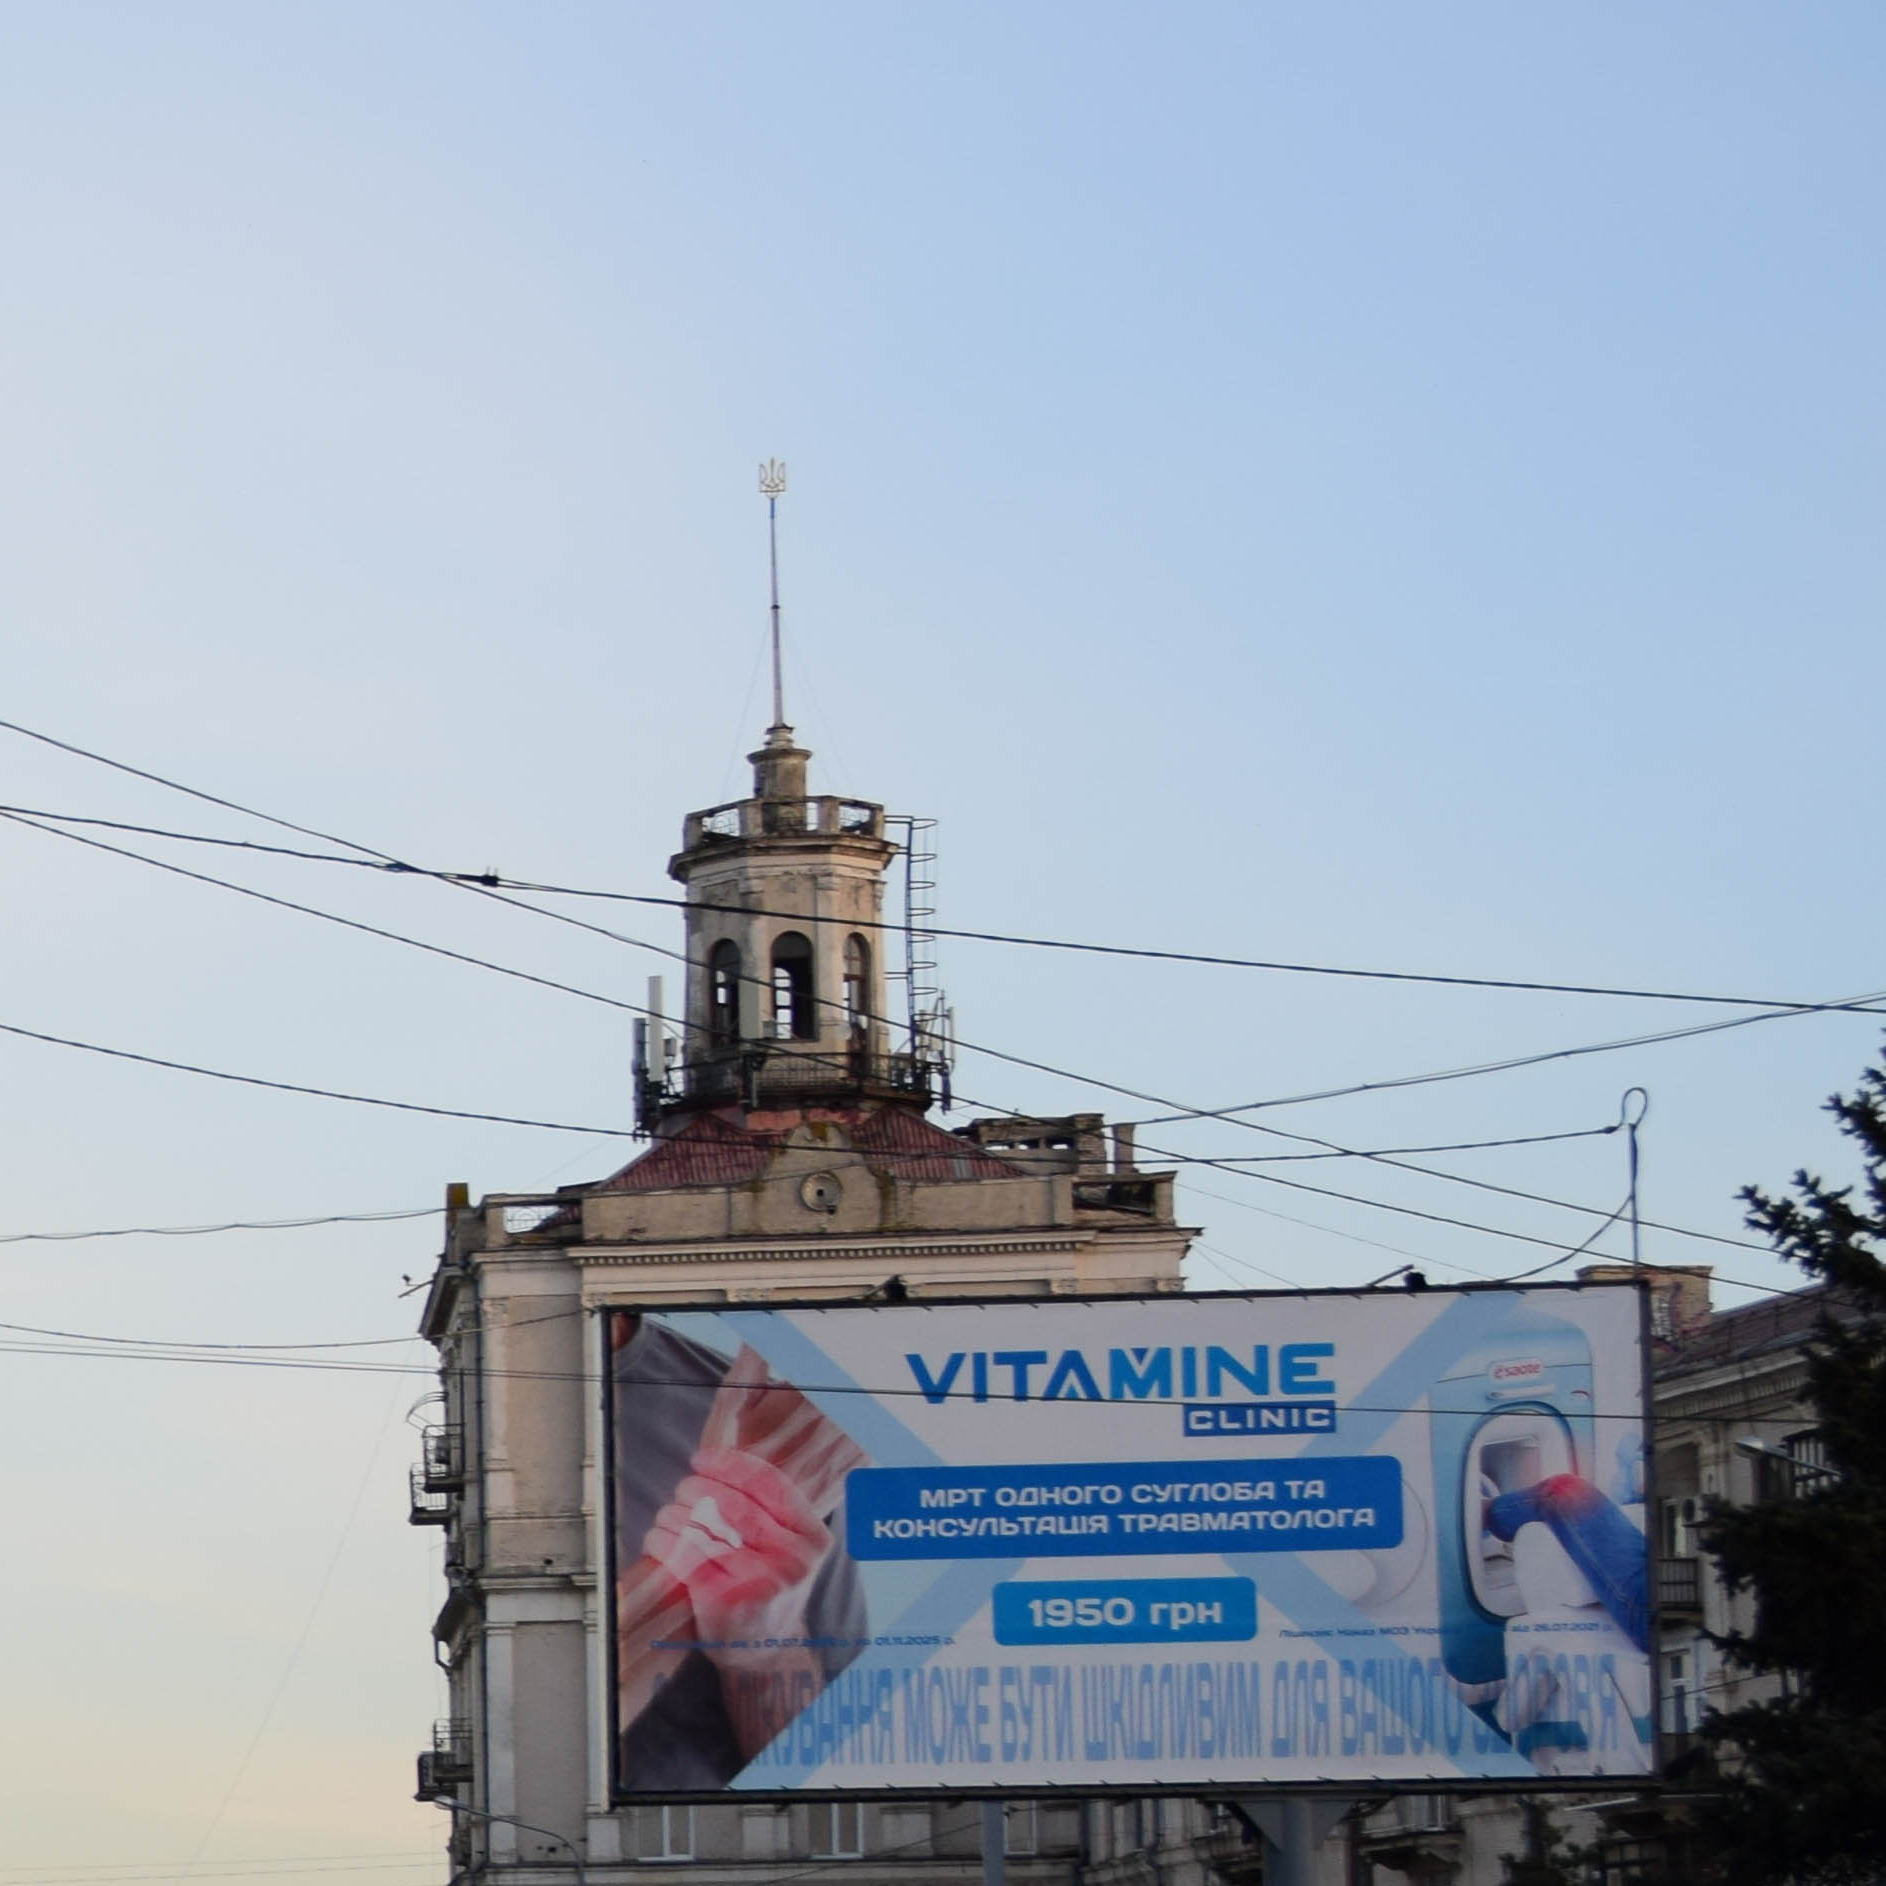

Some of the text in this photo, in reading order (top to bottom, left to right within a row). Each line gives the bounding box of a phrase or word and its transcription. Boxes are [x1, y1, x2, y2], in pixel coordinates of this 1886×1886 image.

[905, 1342, 1336, 1404] VITAMINE
[1188, 1407, 1331, 1431] CLINIC
[920, 1480, 1326, 1509] МРТ ОДНОГО СУГЛОБА ТА
[874, 1508, 1375, 1538] КОНСУЛЬТАЦІЯ ТРАВМАТОЛОГА
[1029, 1598, 1222, 1629] 1950 грн
[904, 1667, 990, 1765] МОЖЕ
[1000, 1665, 1073, 1762] БУТИ
[1083, 1661, 1260, 1761] ШКІДЛИВИМ
[1272, 1660, 1328, 1758] ДЛЯ
[1341, 1657, 1461, 1757] ВАШОГО
